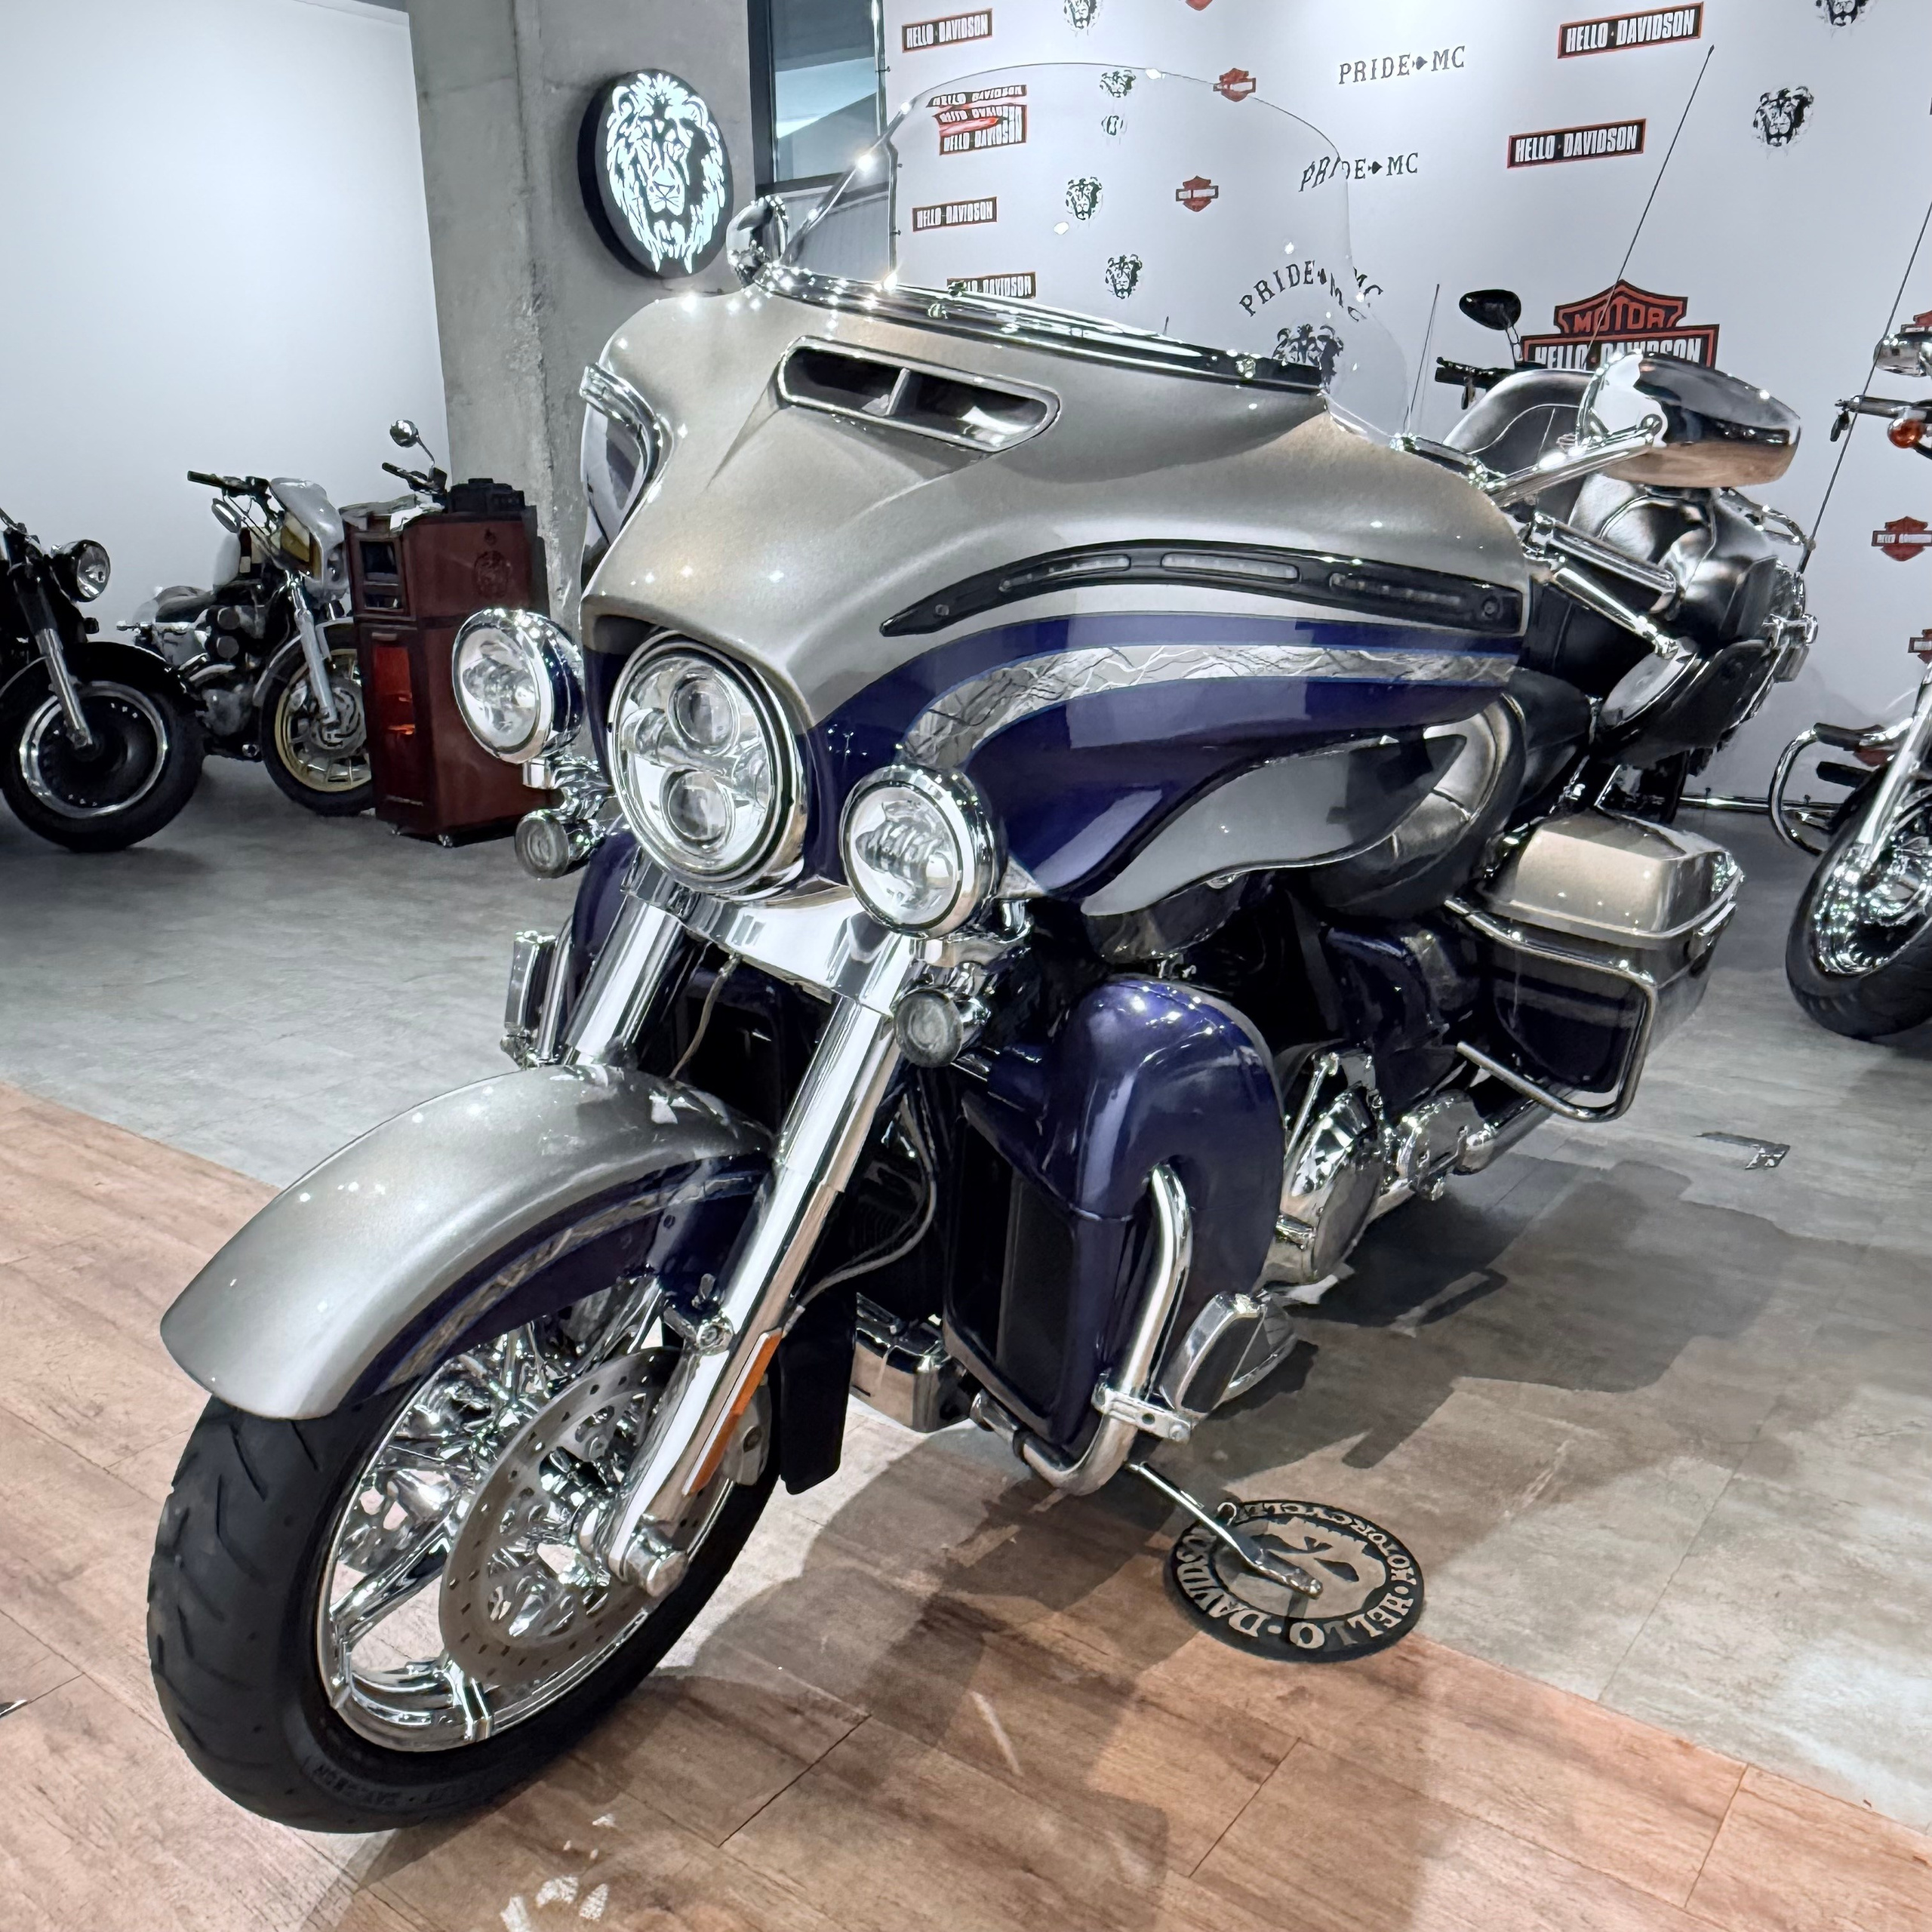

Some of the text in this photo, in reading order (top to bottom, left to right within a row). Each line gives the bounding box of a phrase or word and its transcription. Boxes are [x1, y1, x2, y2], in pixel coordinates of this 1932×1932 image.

[906, 14, 989, 48] HELLO DAVIDSON
[1566, 9, 1695, 53] HELLO DAVIDSON
[1338, 45, 1466, 85] PRIDE MC
[1515, 125, 1638, 162] HELLO DAVIDSON
[1386, 152, 1418, 176] MC
[916, 201, 993, 229] HELLO DAVIDSON
[1238, 260, 1315, 317] PRIDE
[1573, 296, 1666, 333] MOTOR
[1289, 1592, 1414, 1649] HELLO
